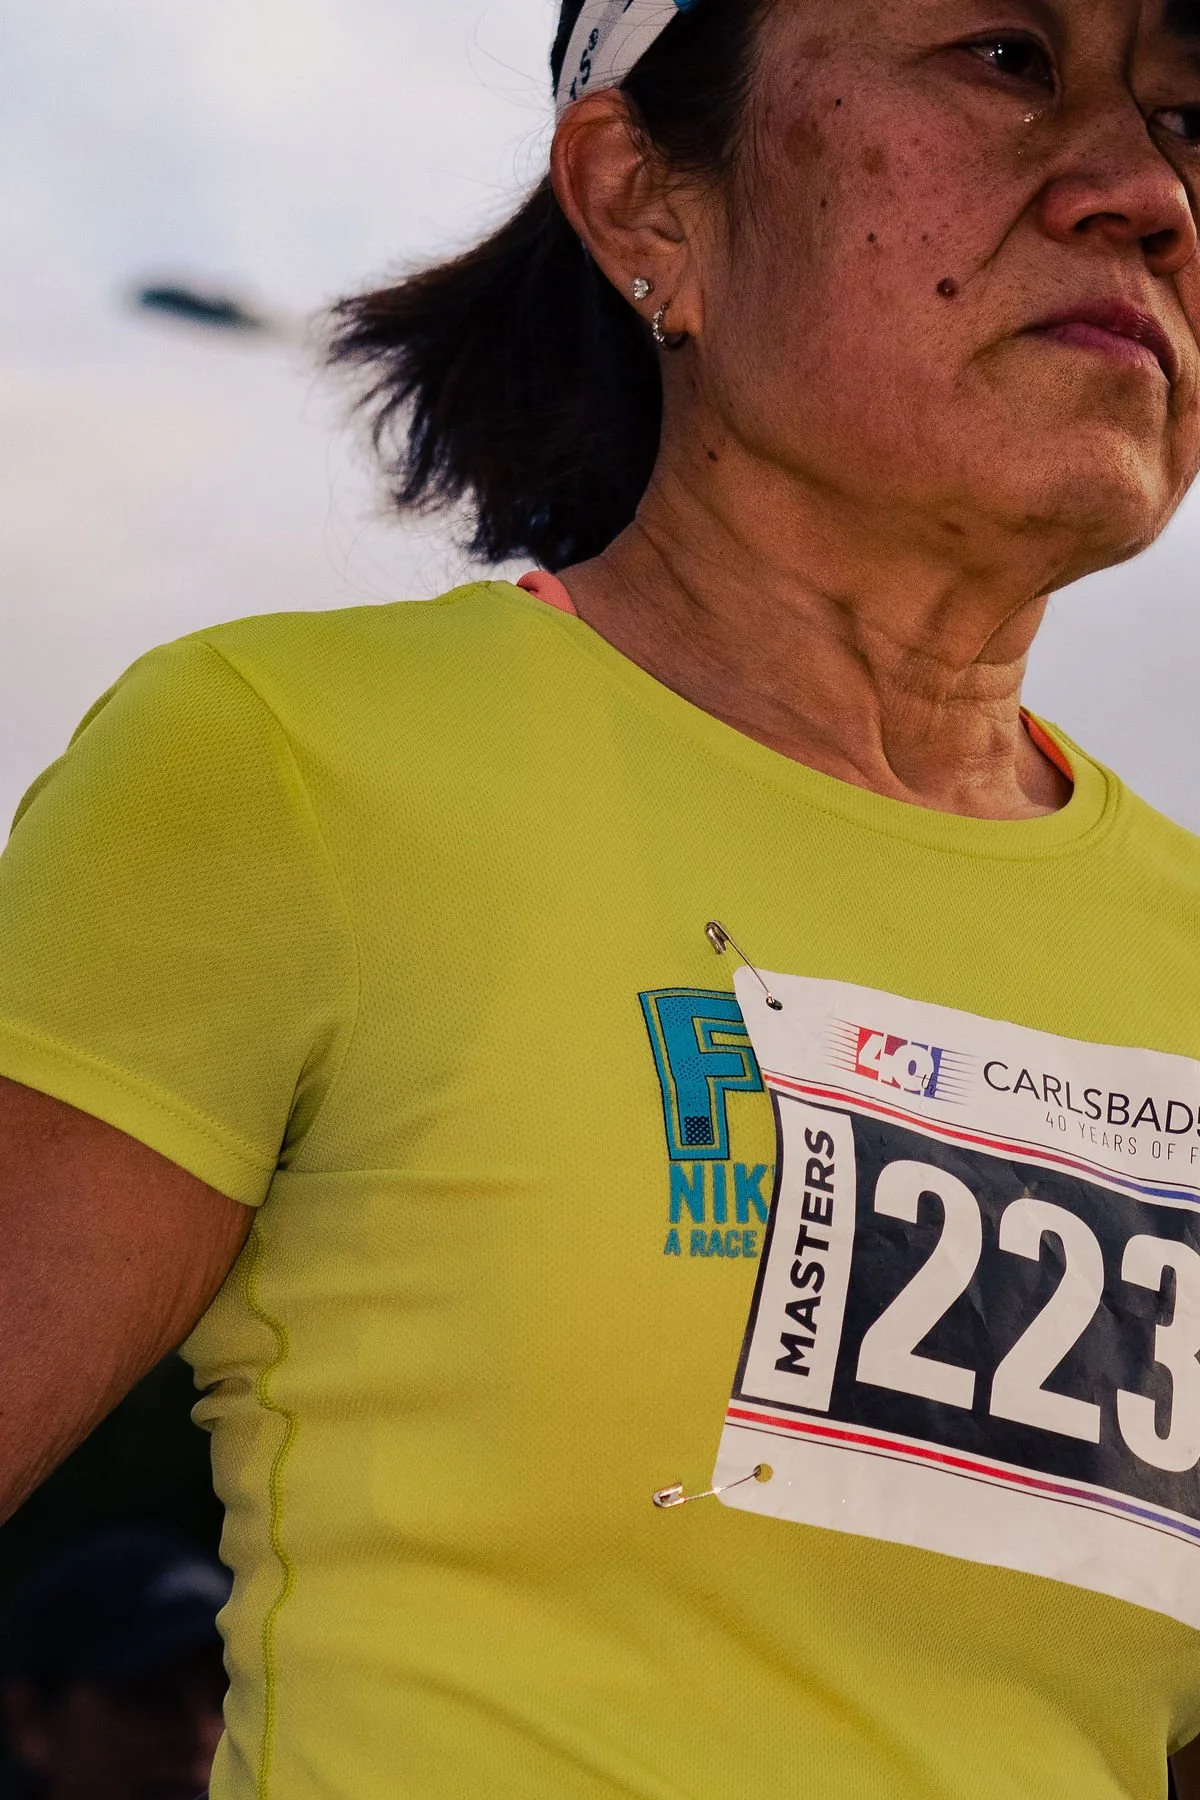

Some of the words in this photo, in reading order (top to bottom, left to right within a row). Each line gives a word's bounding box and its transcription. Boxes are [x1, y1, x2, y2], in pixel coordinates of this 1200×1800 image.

[1045, 1111, 1067, 1132] 40
[1078, 1122, 1137, 1156] YEARS
[1152, 1140, 1176, 1161] OF
[669, 1163, 776, 1224] NIK
[664, 1228, 681, 1256] A
[690, 1229, 758, 1259] RACE
[774, 1126, 835, 1377] MASTERS
